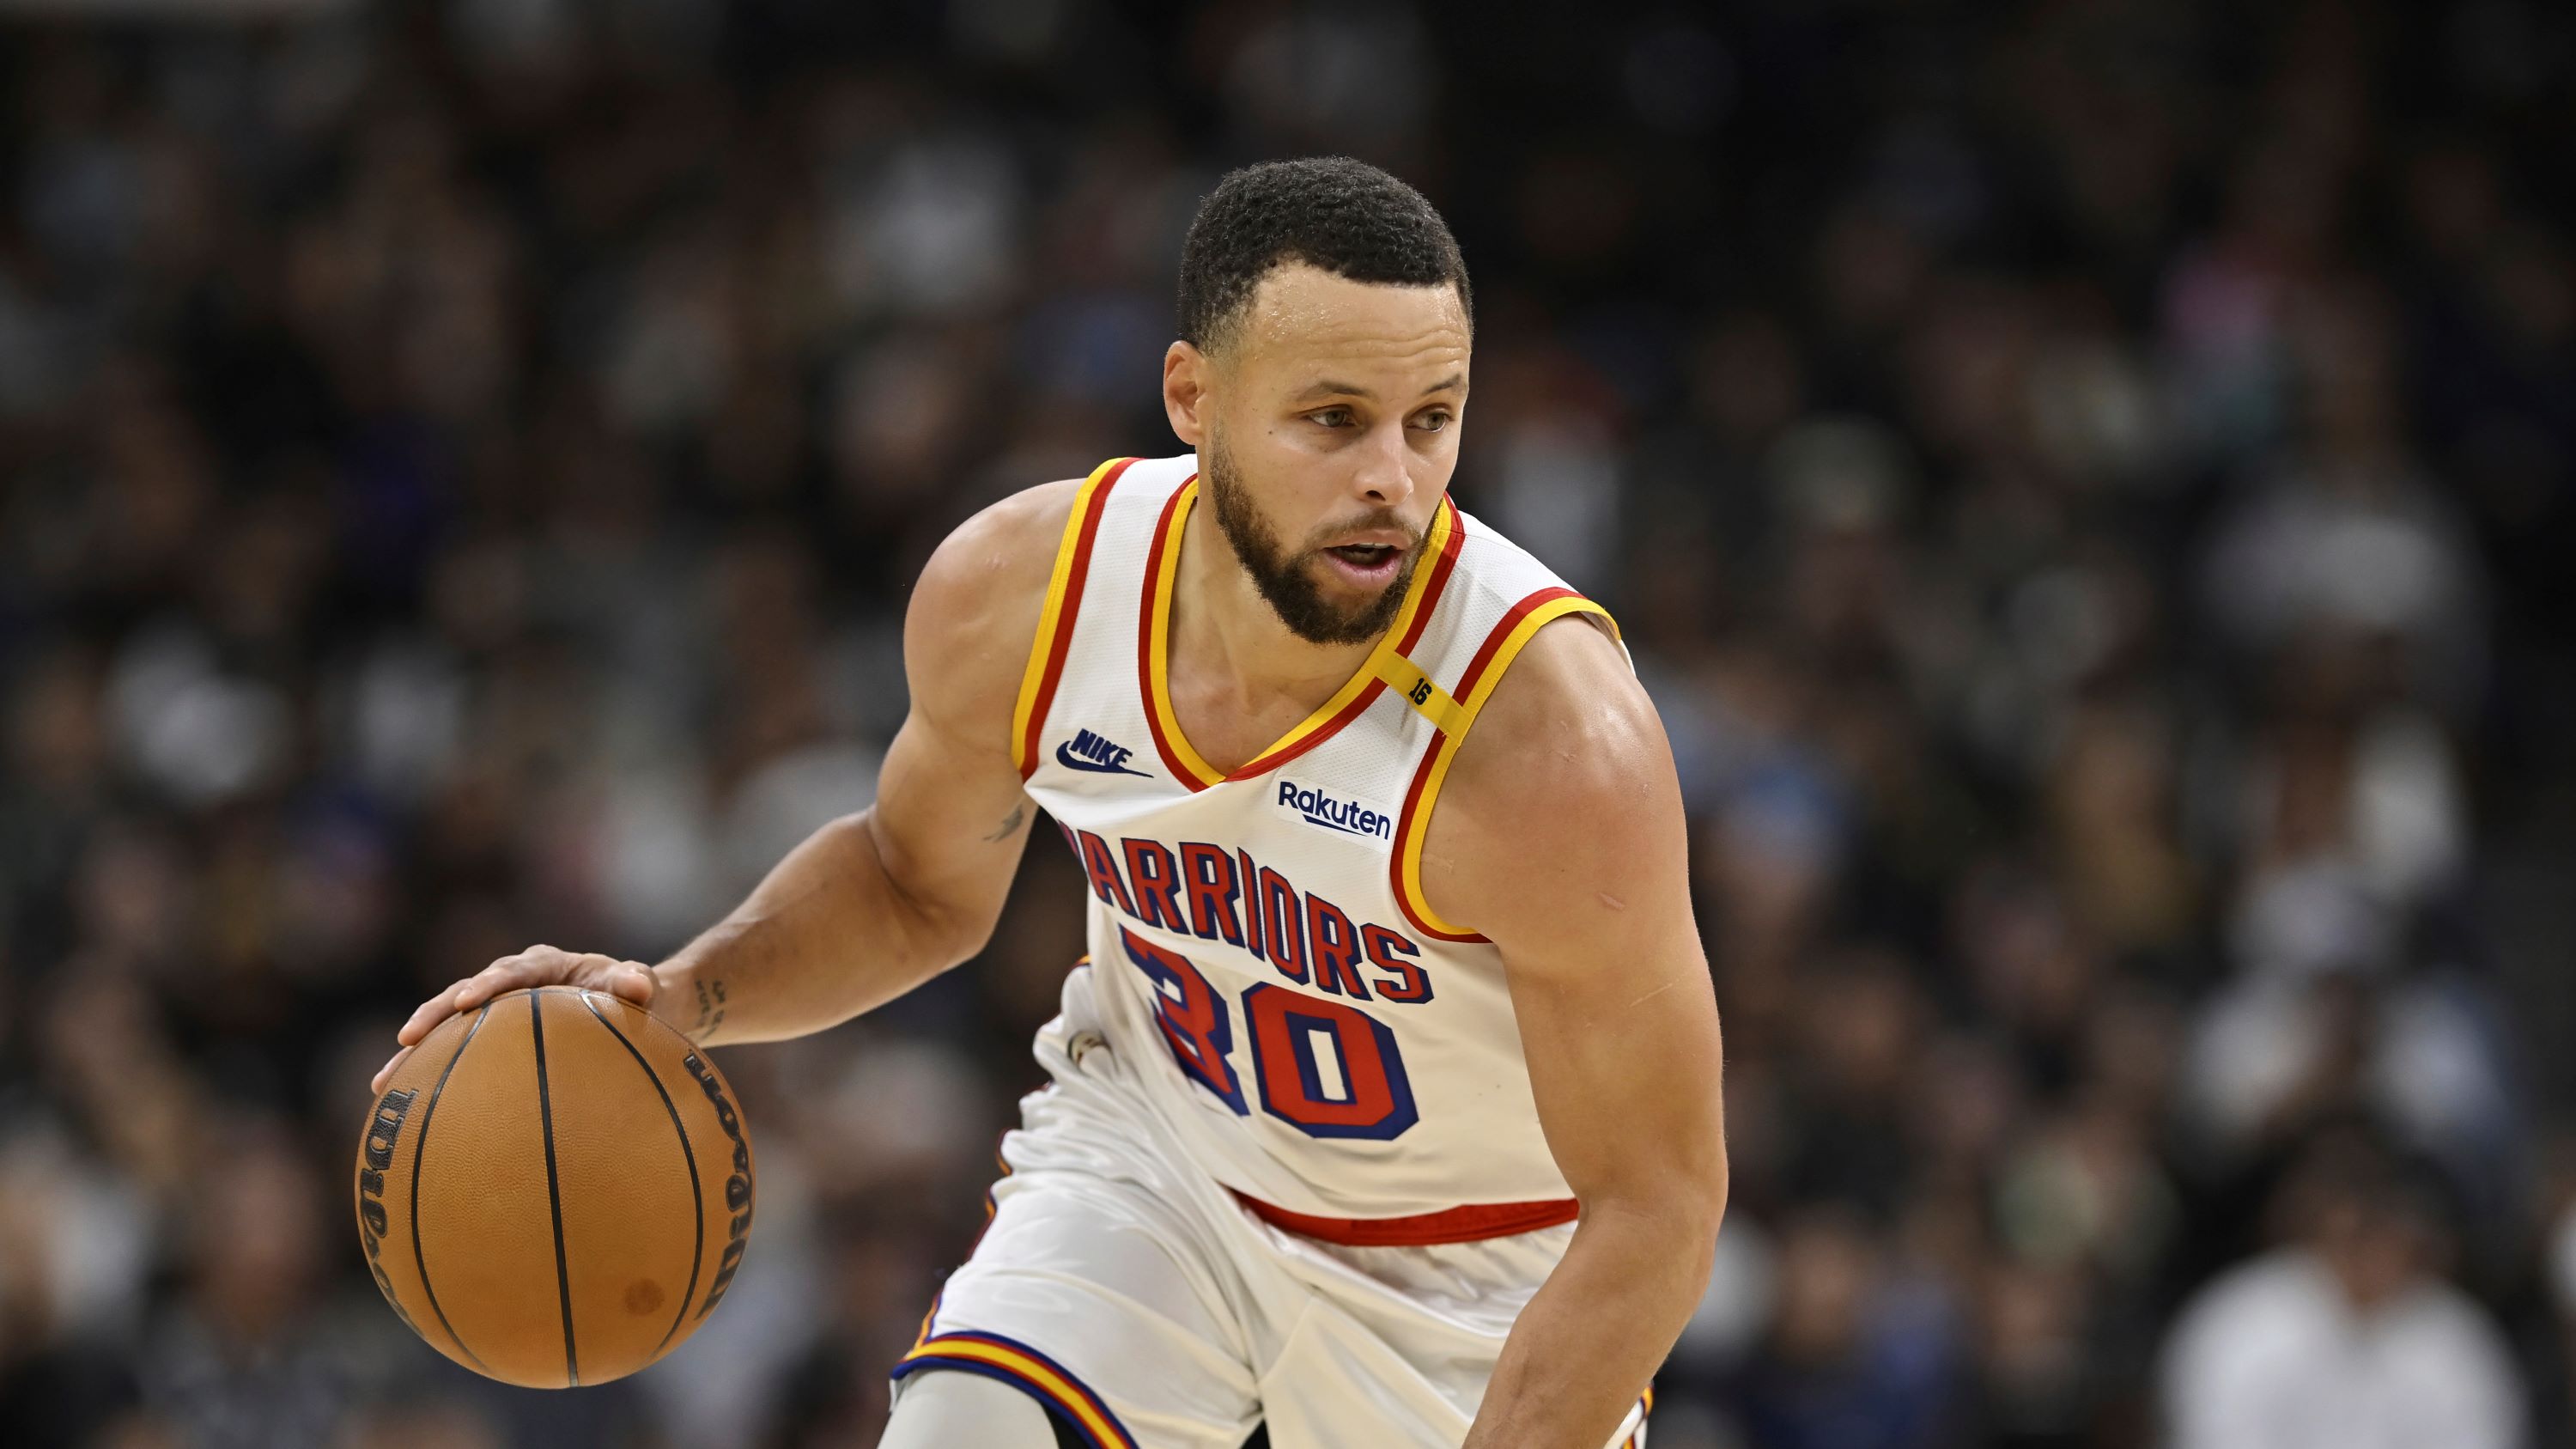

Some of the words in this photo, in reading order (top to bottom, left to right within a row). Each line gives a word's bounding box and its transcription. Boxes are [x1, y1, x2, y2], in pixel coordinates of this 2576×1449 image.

[1070, 728, 1133, 768] NIKE
[1409, 678, 1432, 705] 16
[1279, 782, 1390, 840] Rakuten
[1058, 819, 1435, 1004] ARRIORS
[1118, 922, 1419, 1142] 30
[360, 1089, 427, 1338] Wilso
